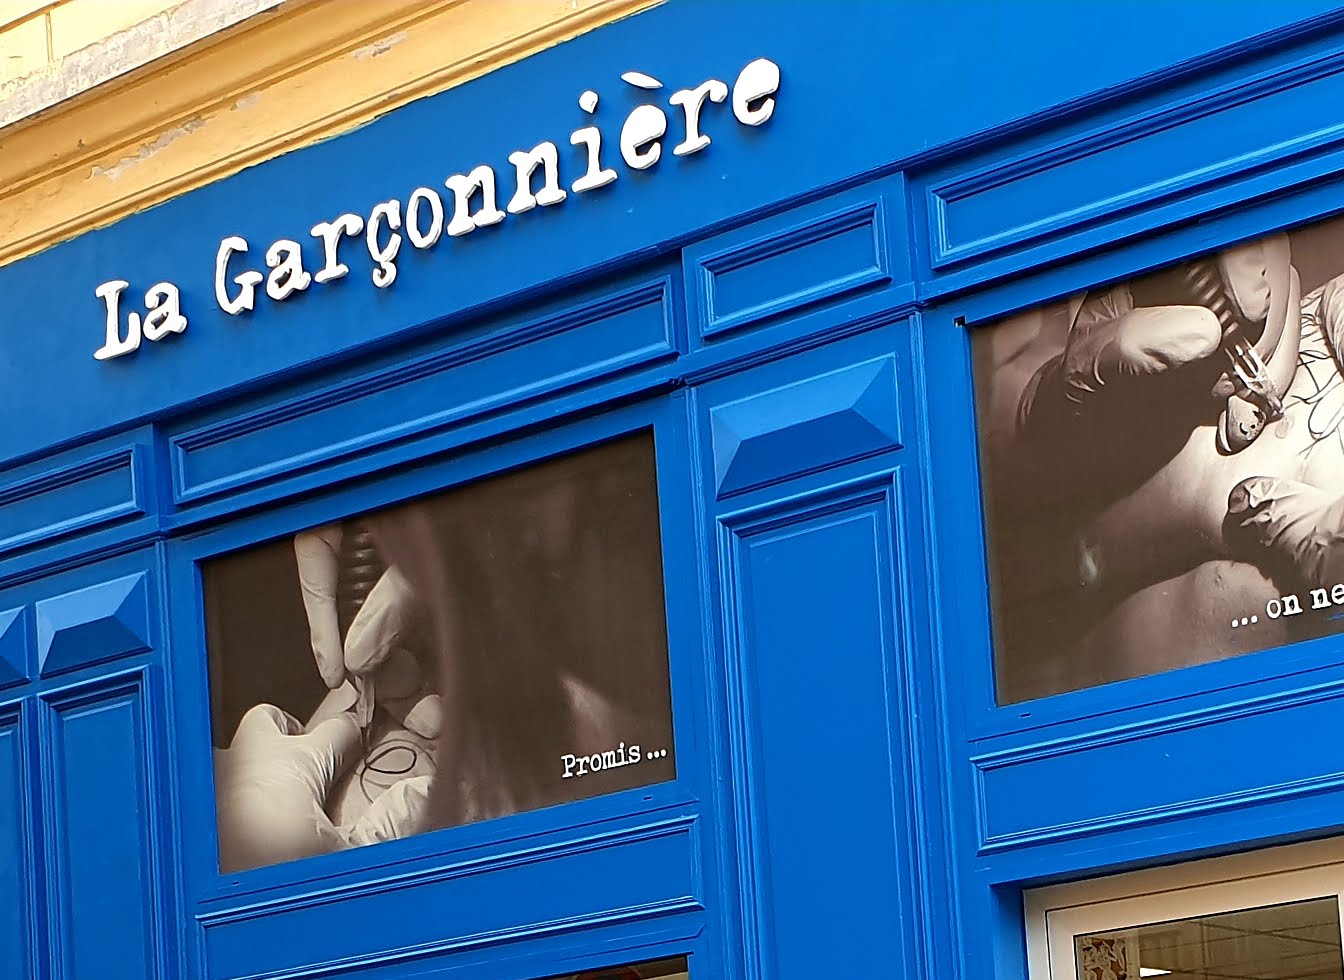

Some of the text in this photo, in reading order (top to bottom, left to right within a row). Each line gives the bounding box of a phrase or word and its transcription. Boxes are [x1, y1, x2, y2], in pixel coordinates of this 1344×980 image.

[93, 57, 782, 361] La Garçonnière
[1266, 590, 1303, 619] on
[560, 741, 641, 778] Promis
